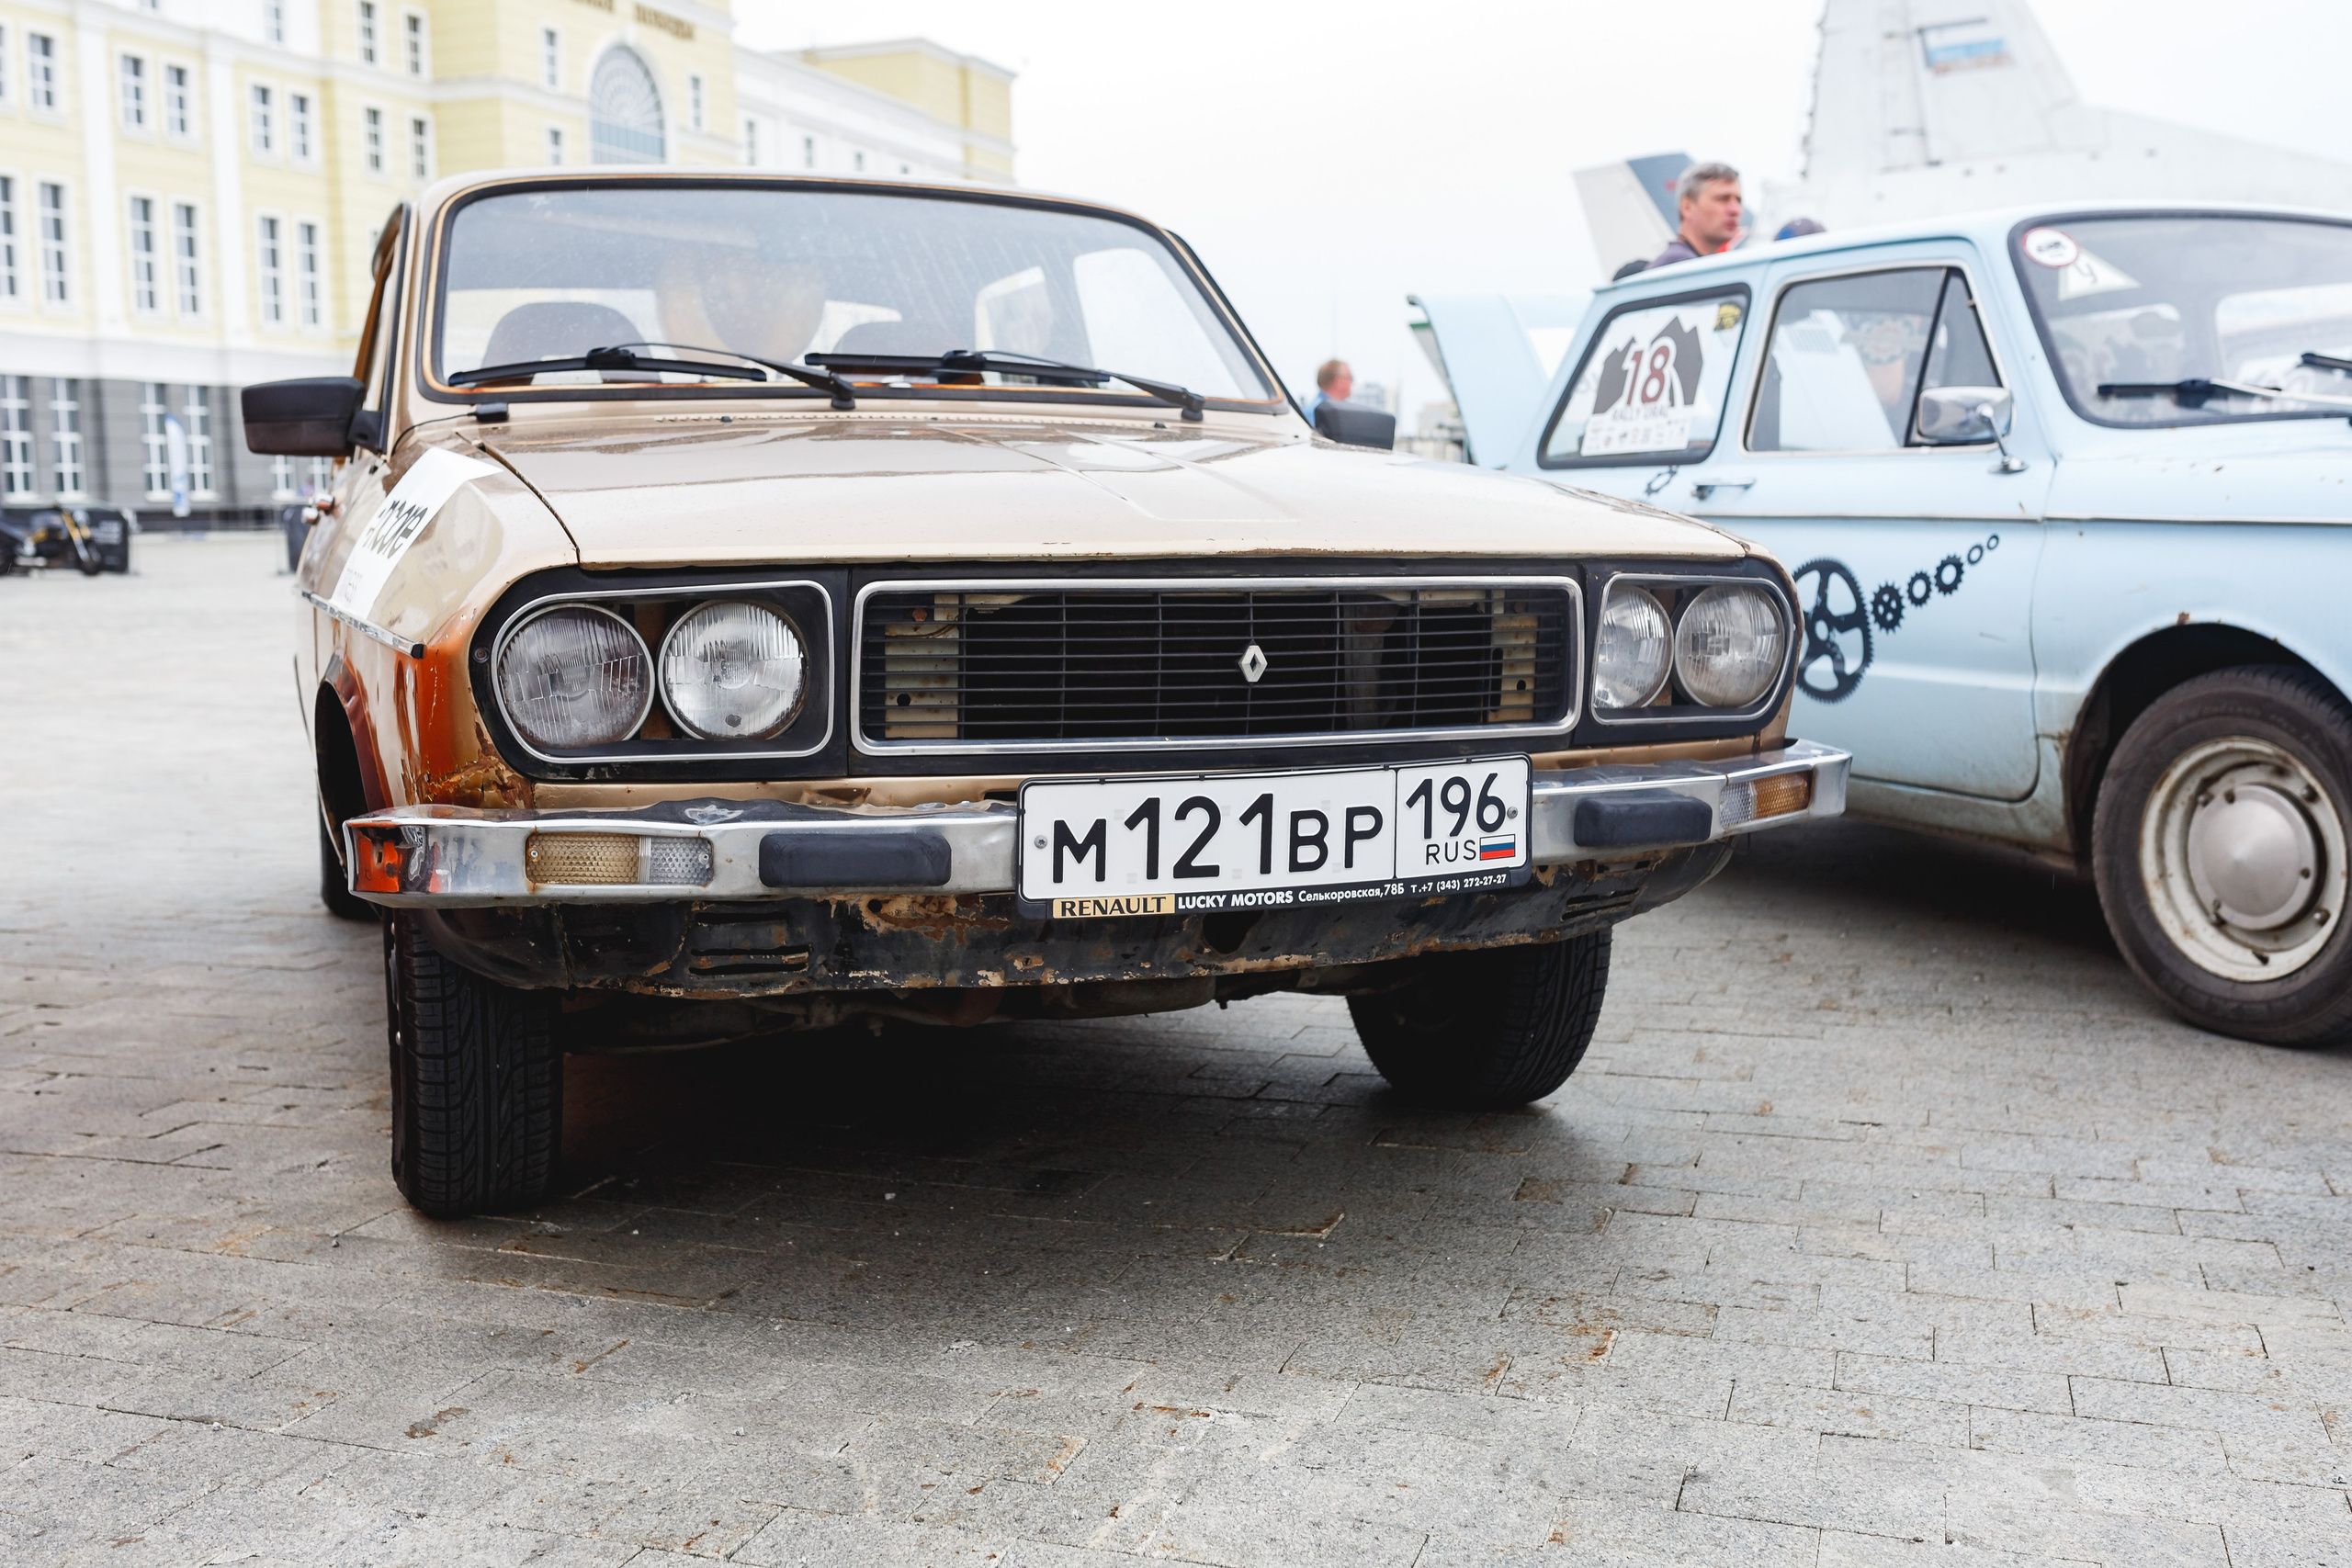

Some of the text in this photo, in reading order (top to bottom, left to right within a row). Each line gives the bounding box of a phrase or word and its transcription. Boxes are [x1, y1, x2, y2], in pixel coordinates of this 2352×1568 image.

[1626, 345, 1670, 406] 18
[1406, 773, 1506, 840] 196
[1426, 840, 1476, 865] RUS
[1060, 896, 1167, 917] RENAULT
[1178, 894, 1227, 909] LUCKY
[1230, 890, 1294, 907] MOTORS
[1436, 878, 1461, 893] (343)
[1464, 874, 1507, 888] 272-27-27
